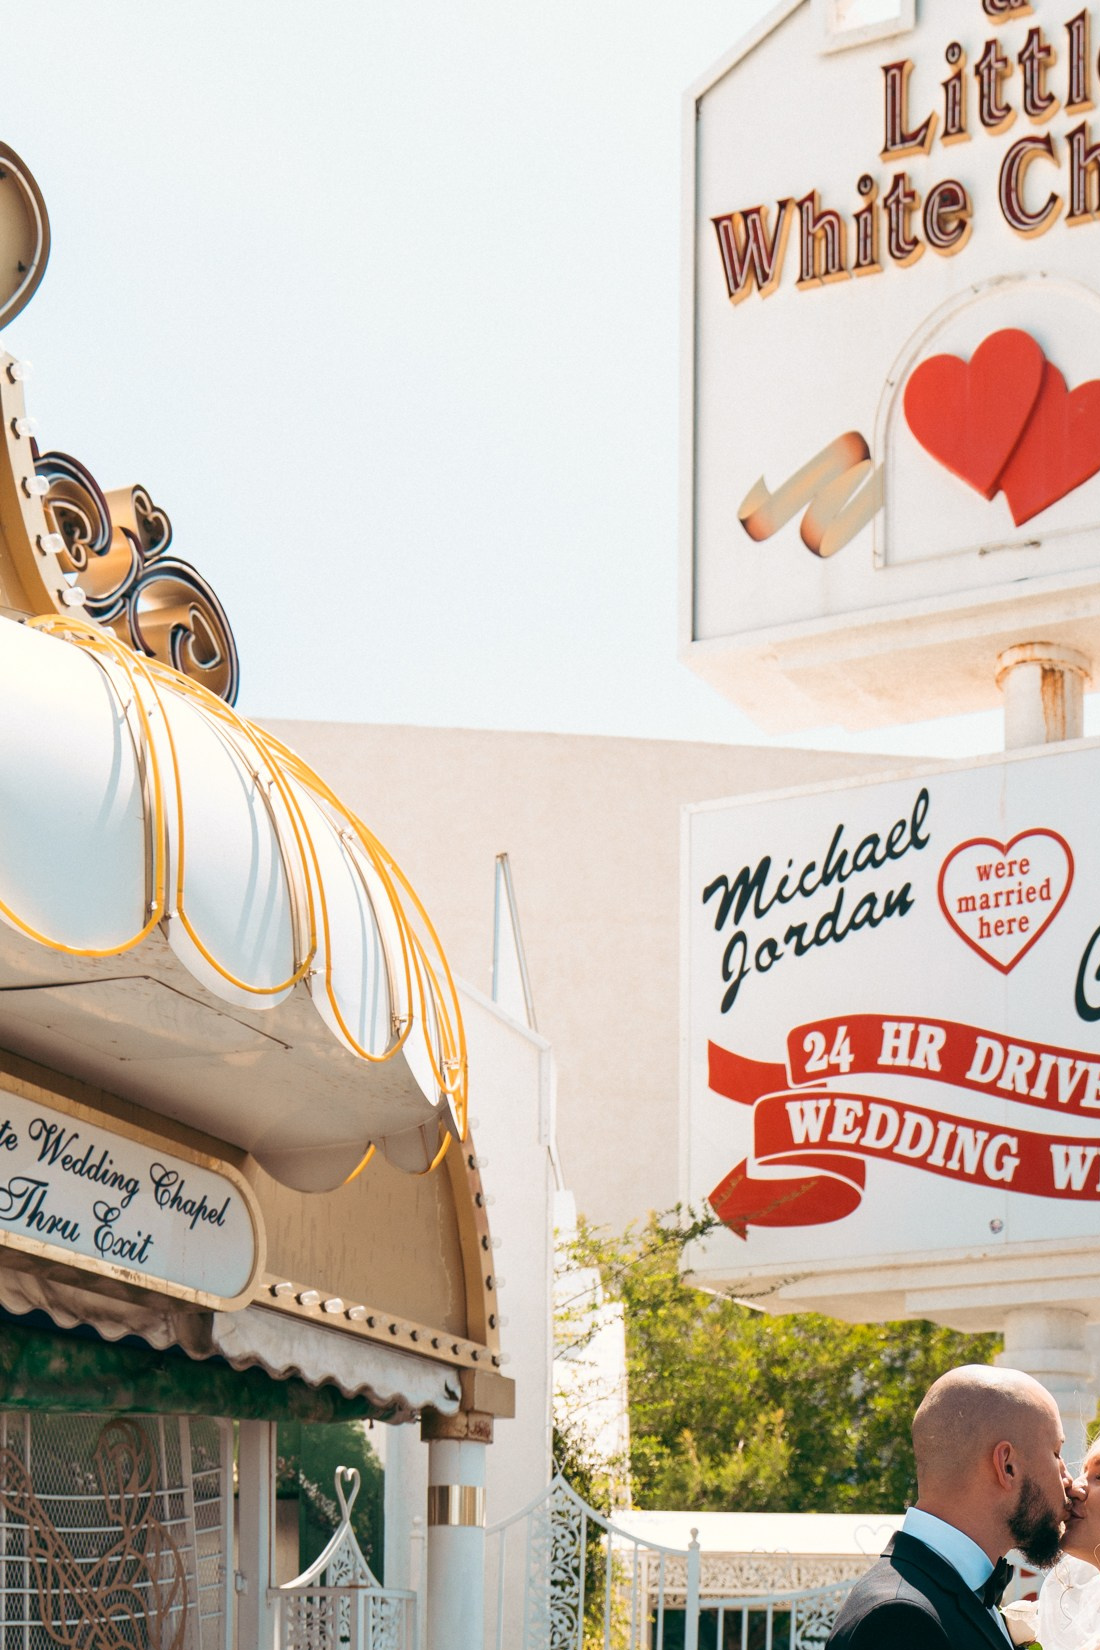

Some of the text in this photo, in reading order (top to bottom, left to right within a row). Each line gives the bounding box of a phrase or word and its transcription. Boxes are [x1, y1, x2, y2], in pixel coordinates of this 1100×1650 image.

[711, 172, 973, 306] White
[703, 787, 930, 931] Michael
[956, 878, 1052, 915] married
[976, 855, 1031, 882] were
[721, 881, 915, 1013] Jordan
[978, 912, 1030, 939] here
[802, 1026, 854, 1074] 24
[878, 1021, 946, 1070] HR
[28, 1118, 140, 1209] Wedding
[150, 1162, 231, 1230] Chapel
[786, 1100, 1020, 1182] WEDDING
[0, 1176, 154, 1264] Thru Exit
